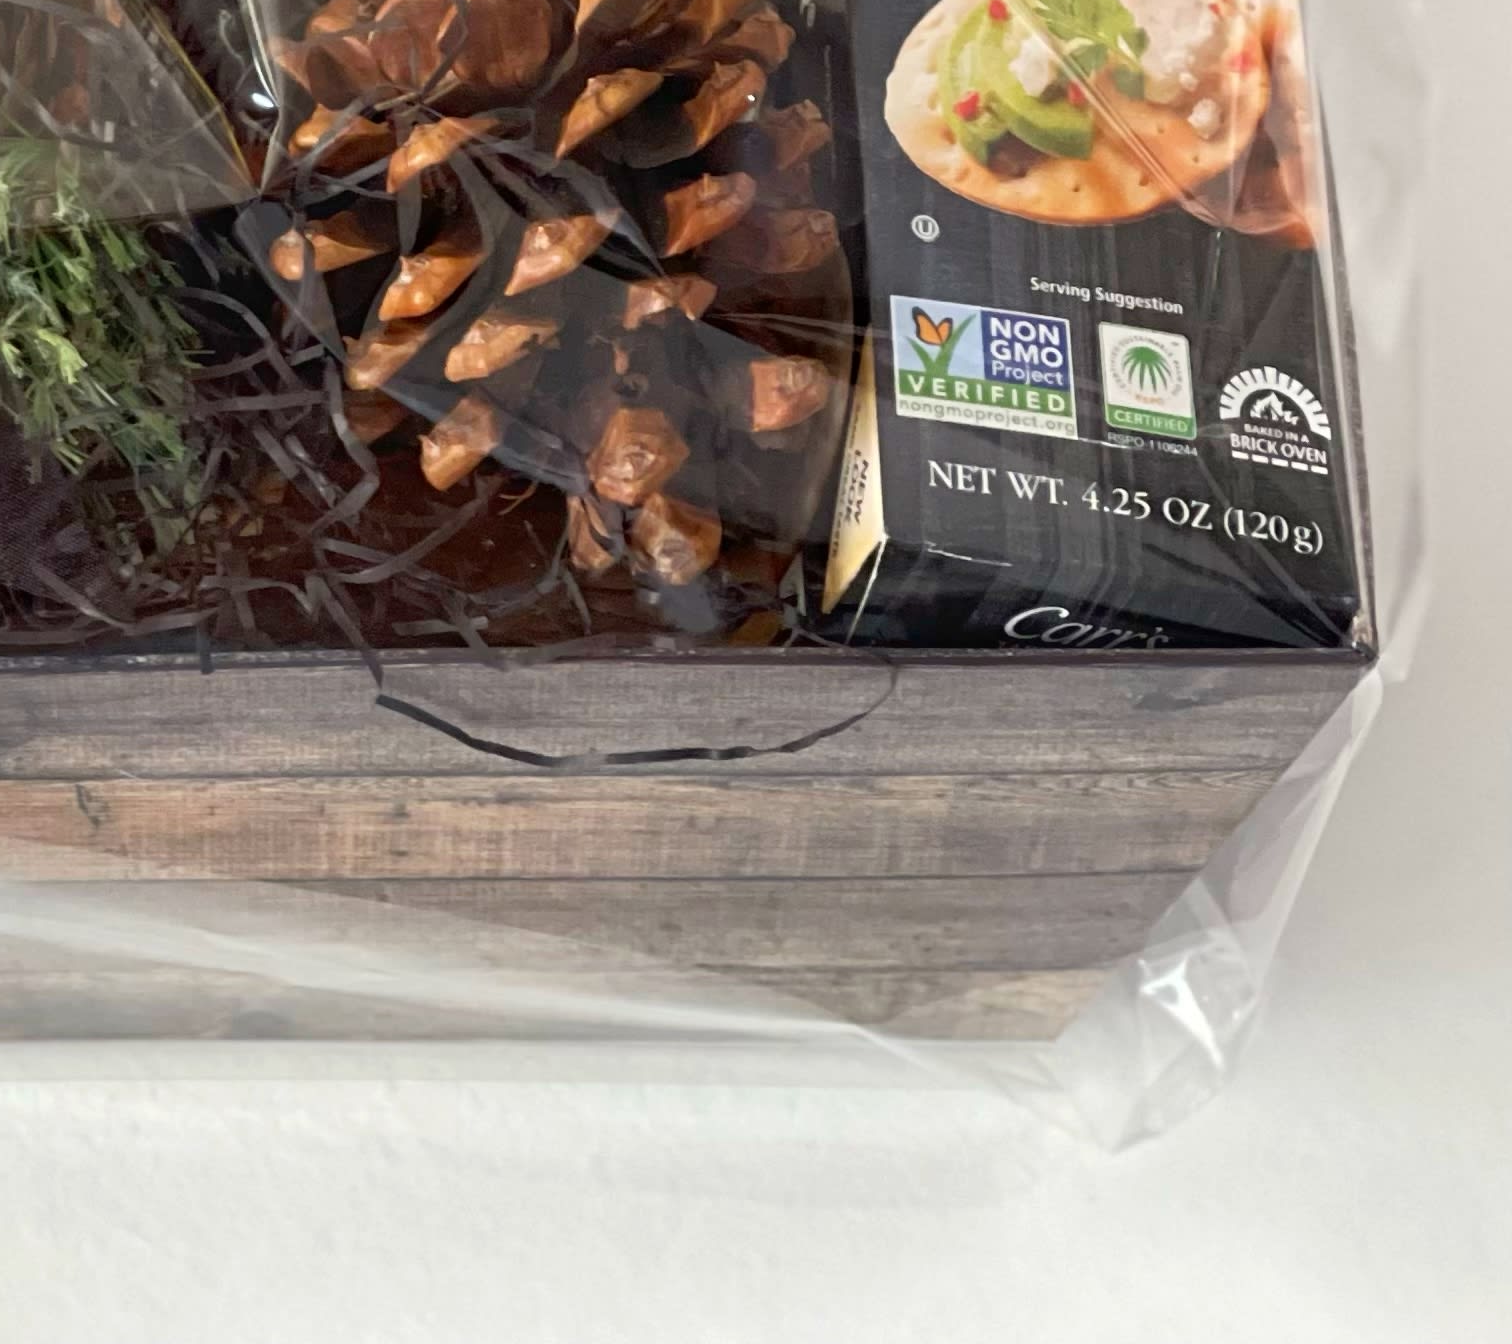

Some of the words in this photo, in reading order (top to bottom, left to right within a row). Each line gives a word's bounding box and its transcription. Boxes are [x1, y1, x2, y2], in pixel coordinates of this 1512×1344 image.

[1030, 276, 1091, 302] Serving
[1095, 287, 1184, 316] Suggestion
[990, 317, 1060, 346] NON
[990, 339, 1064, 368] GMO
[991, 360, 1065, 386] Project
[907, 373, 1066, 412] VERIFIED
[899, 398, 1075, 437] nongmoproject.org
[1114, 409, 1188, 434] CERTIFIED
[1230, 432, 1279, 455] BRICK
[1280, 443, 1328, 465] OVEN
[1243, 423, 1283, 438] BAKED
[1285, 431, 1299, 442] IN
[1300, 434, 1310, 444] A
[928, 460, 997, 495] NET
[1007, 470, 1069, 507] WT.
[1081, 481, 1151, 520] 4.25
[1162, 496, 1214, 531] OZ
